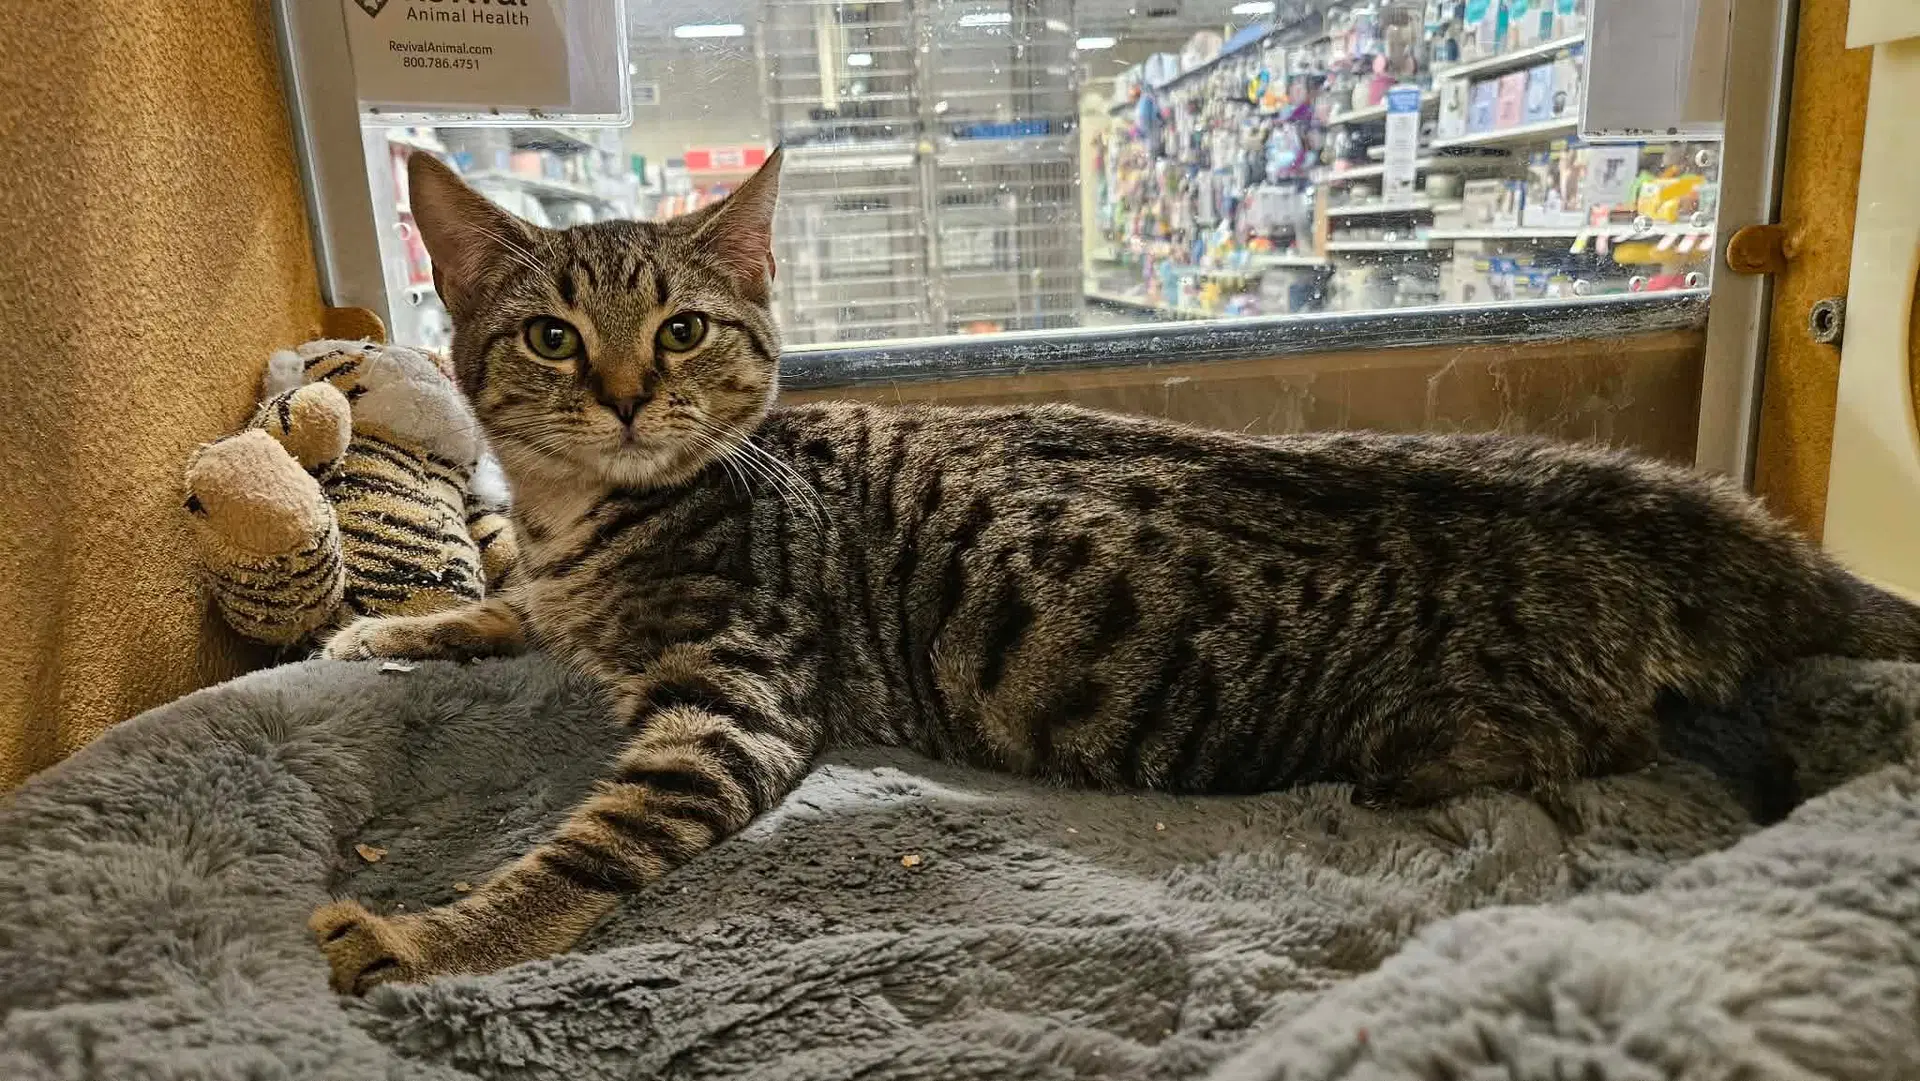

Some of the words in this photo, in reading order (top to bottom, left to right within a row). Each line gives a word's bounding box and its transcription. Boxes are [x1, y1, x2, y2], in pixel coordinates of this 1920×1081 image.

[406, 6, 466, 23] Animal
[473, 8, 530, 26] Health
[389, 40, 493, 55] RevivalAnimal.com
[403, 56, 480, 70] 800.786.4751
